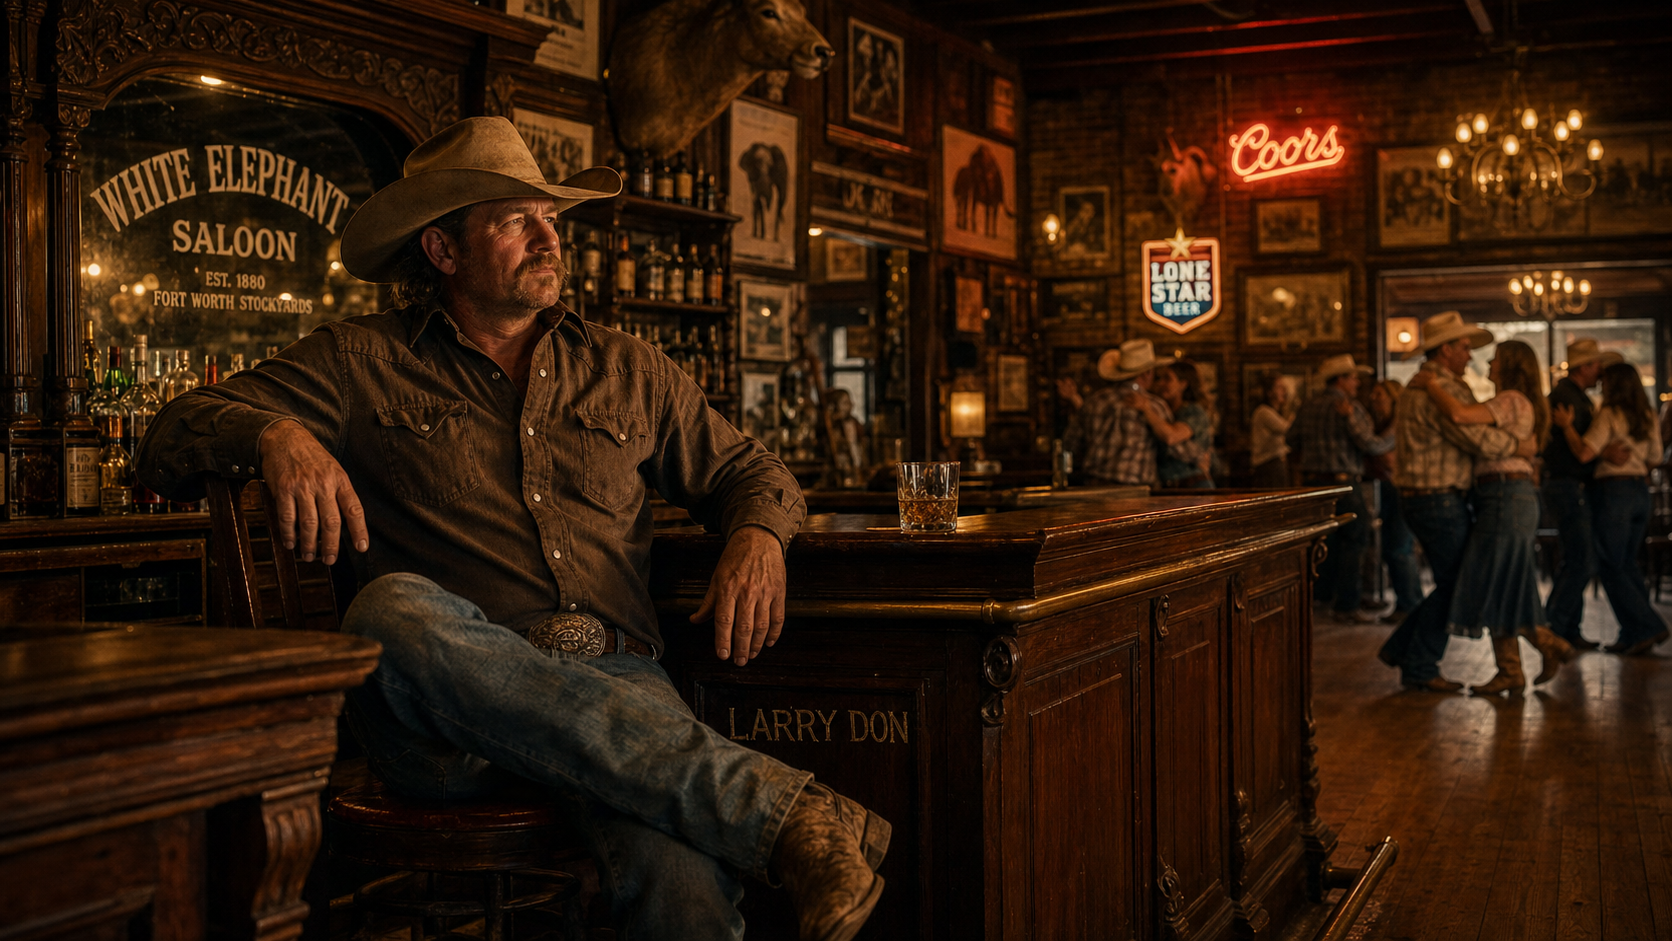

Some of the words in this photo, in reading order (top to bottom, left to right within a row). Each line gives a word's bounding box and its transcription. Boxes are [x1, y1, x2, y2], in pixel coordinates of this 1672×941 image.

[1229, 123, 1339, 177] Coors
[90, 148, 196, 232] WHITE
[204, 145, 350, 234] ELEPHANT
[173, 219, 297, 262] SALOON
[205, 271, 231, 288] EST.
[236, 274, 266, 290] 1880
[1151, 260, 1211, 282] LONE
[154, 290, 187, 308] FORT
[191, 292, 235, 310] WORTH
[239, 293, 313, 314] STOCKYARDS
[1151, 281, 1212, 303] STAR
[1163, 301, 1201, 316] BEER
[729, 707, 837, 743] LARRY
[848, 710, 909, 744] DON
